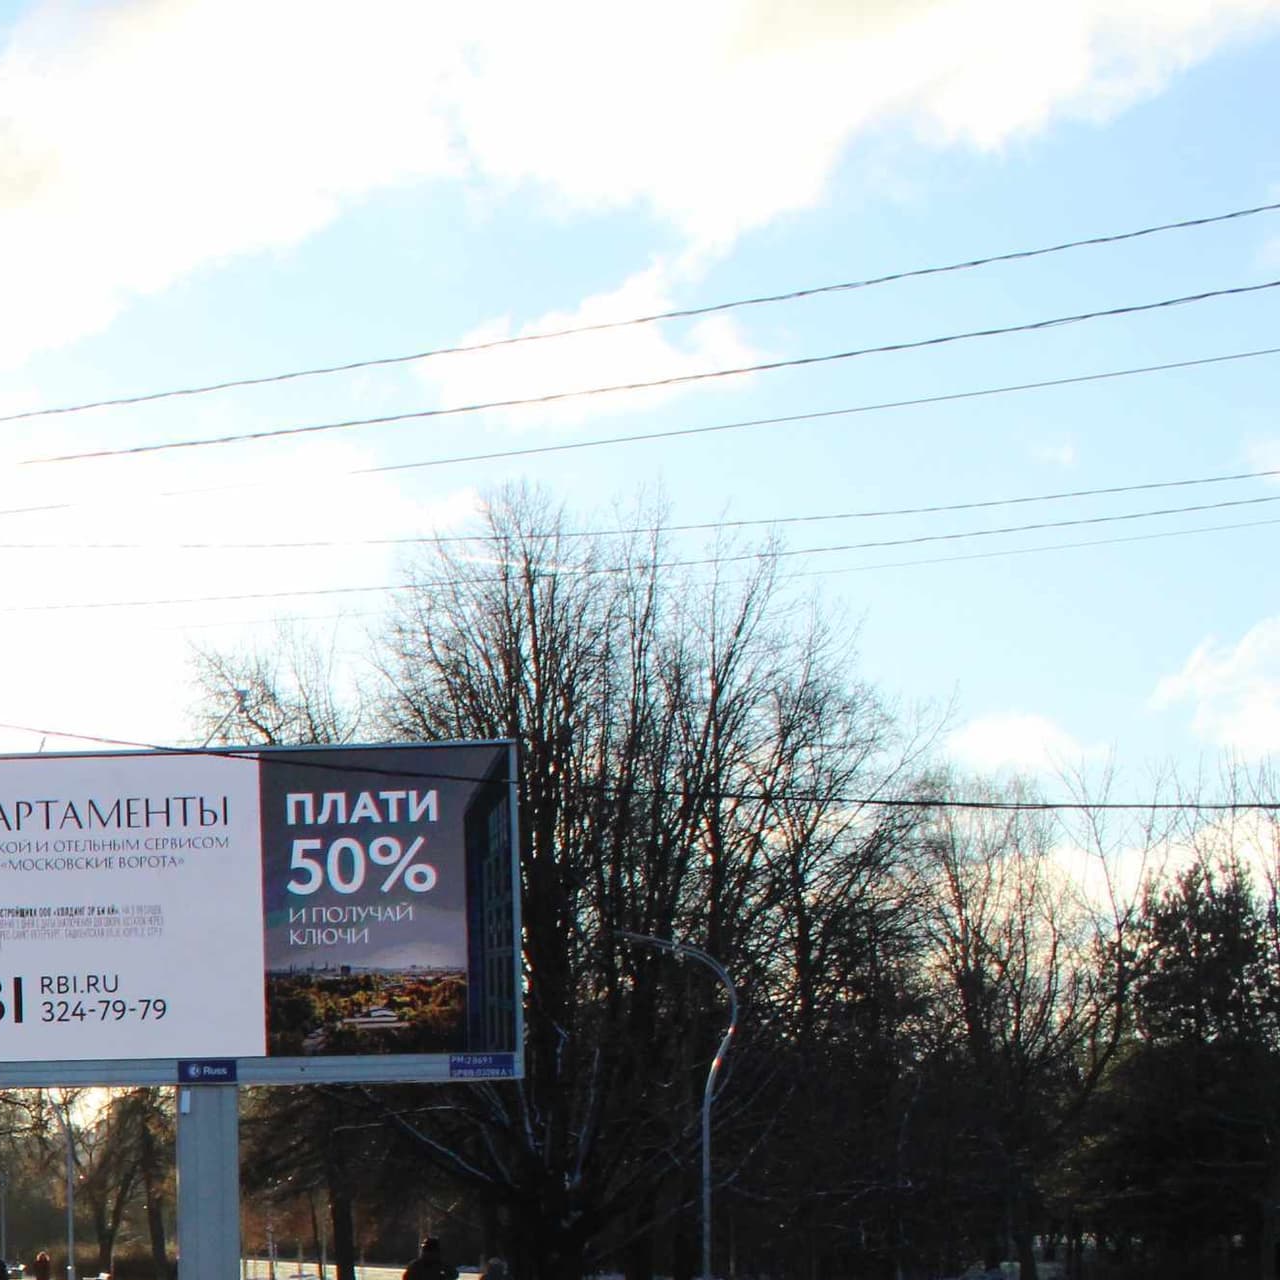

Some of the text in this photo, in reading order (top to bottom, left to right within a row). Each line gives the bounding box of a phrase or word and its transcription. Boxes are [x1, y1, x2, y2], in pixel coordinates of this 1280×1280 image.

[286, 790, 438, 825] ПЛАТИ
[36, 841, 49, 854] И
[53, 837, 140, 853] ОТЕЛЬНЫМ
[143, 836, 230, 851] СЕРВИСОМ
[1, 857, 114, 871] «МОСКОВСКИЕ
[118, 855, 185, 870] ВОРОТА»
[287, 836, 437, 895] 50%
[289, 902, 413, 924] И ПОЛУЧАЙ
[289, 928, 369, 945] КЛЮЧИ
[40, 974, 119, 994] RBI.RU
[41, 998, 167, 1022] 324-79-79
